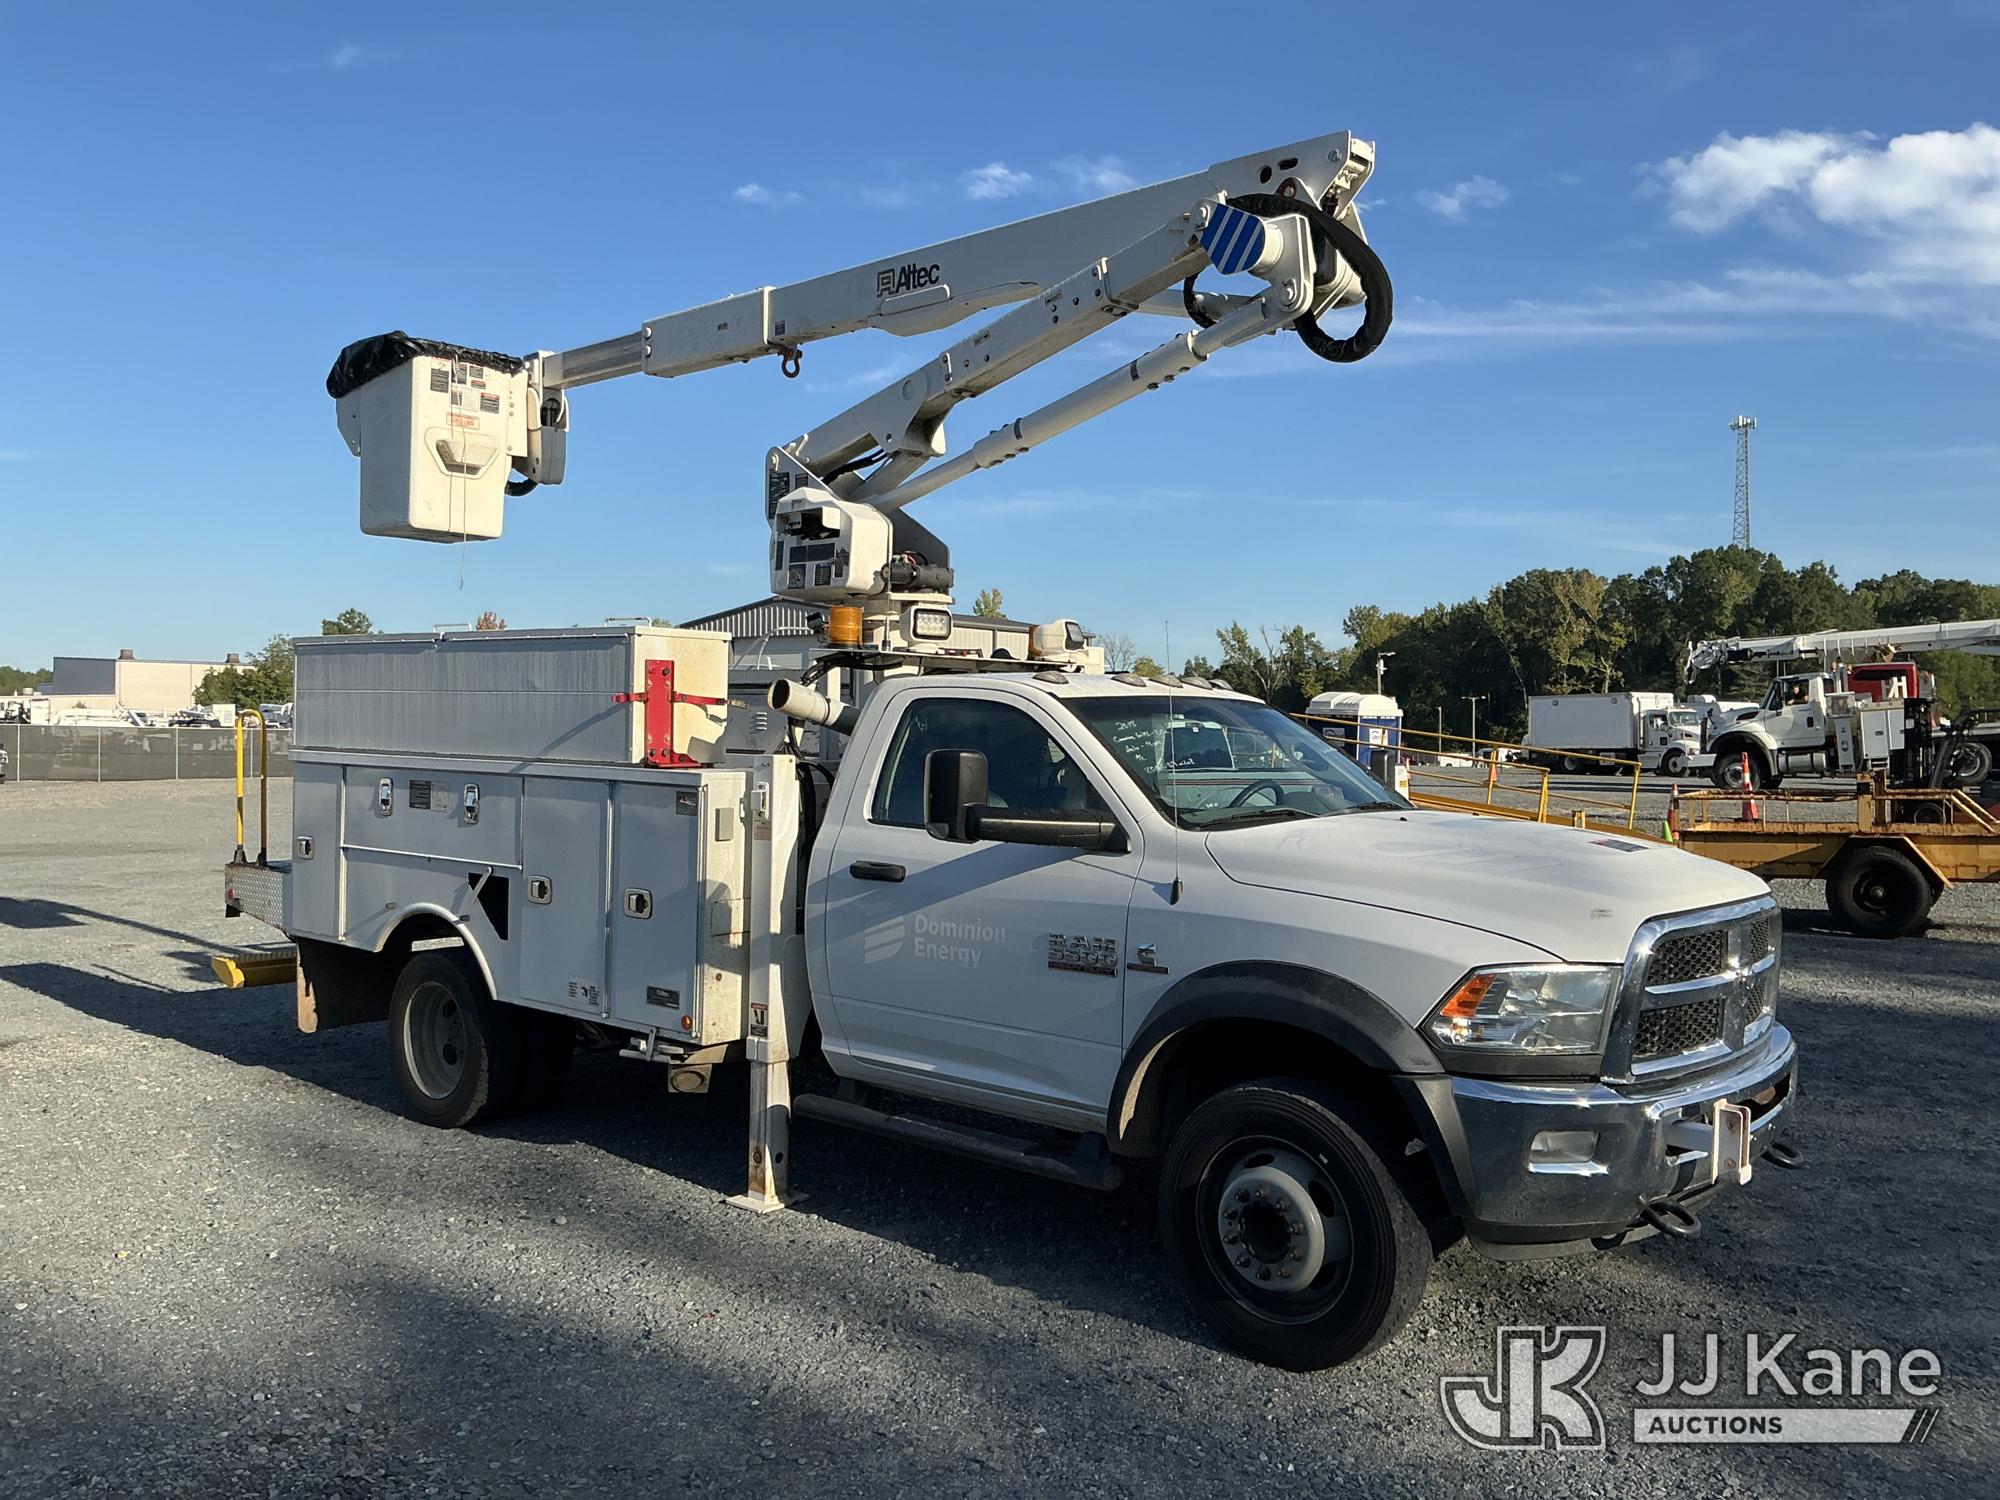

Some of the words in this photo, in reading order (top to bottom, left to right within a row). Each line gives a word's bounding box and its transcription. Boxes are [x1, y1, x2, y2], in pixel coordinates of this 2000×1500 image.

[895, 263, 940, 293] Altec
[914, 914, 1006, 943] Dominion
[1048, 934, 1117, 952] RAM
[914, 936, 982, 968] Energy
